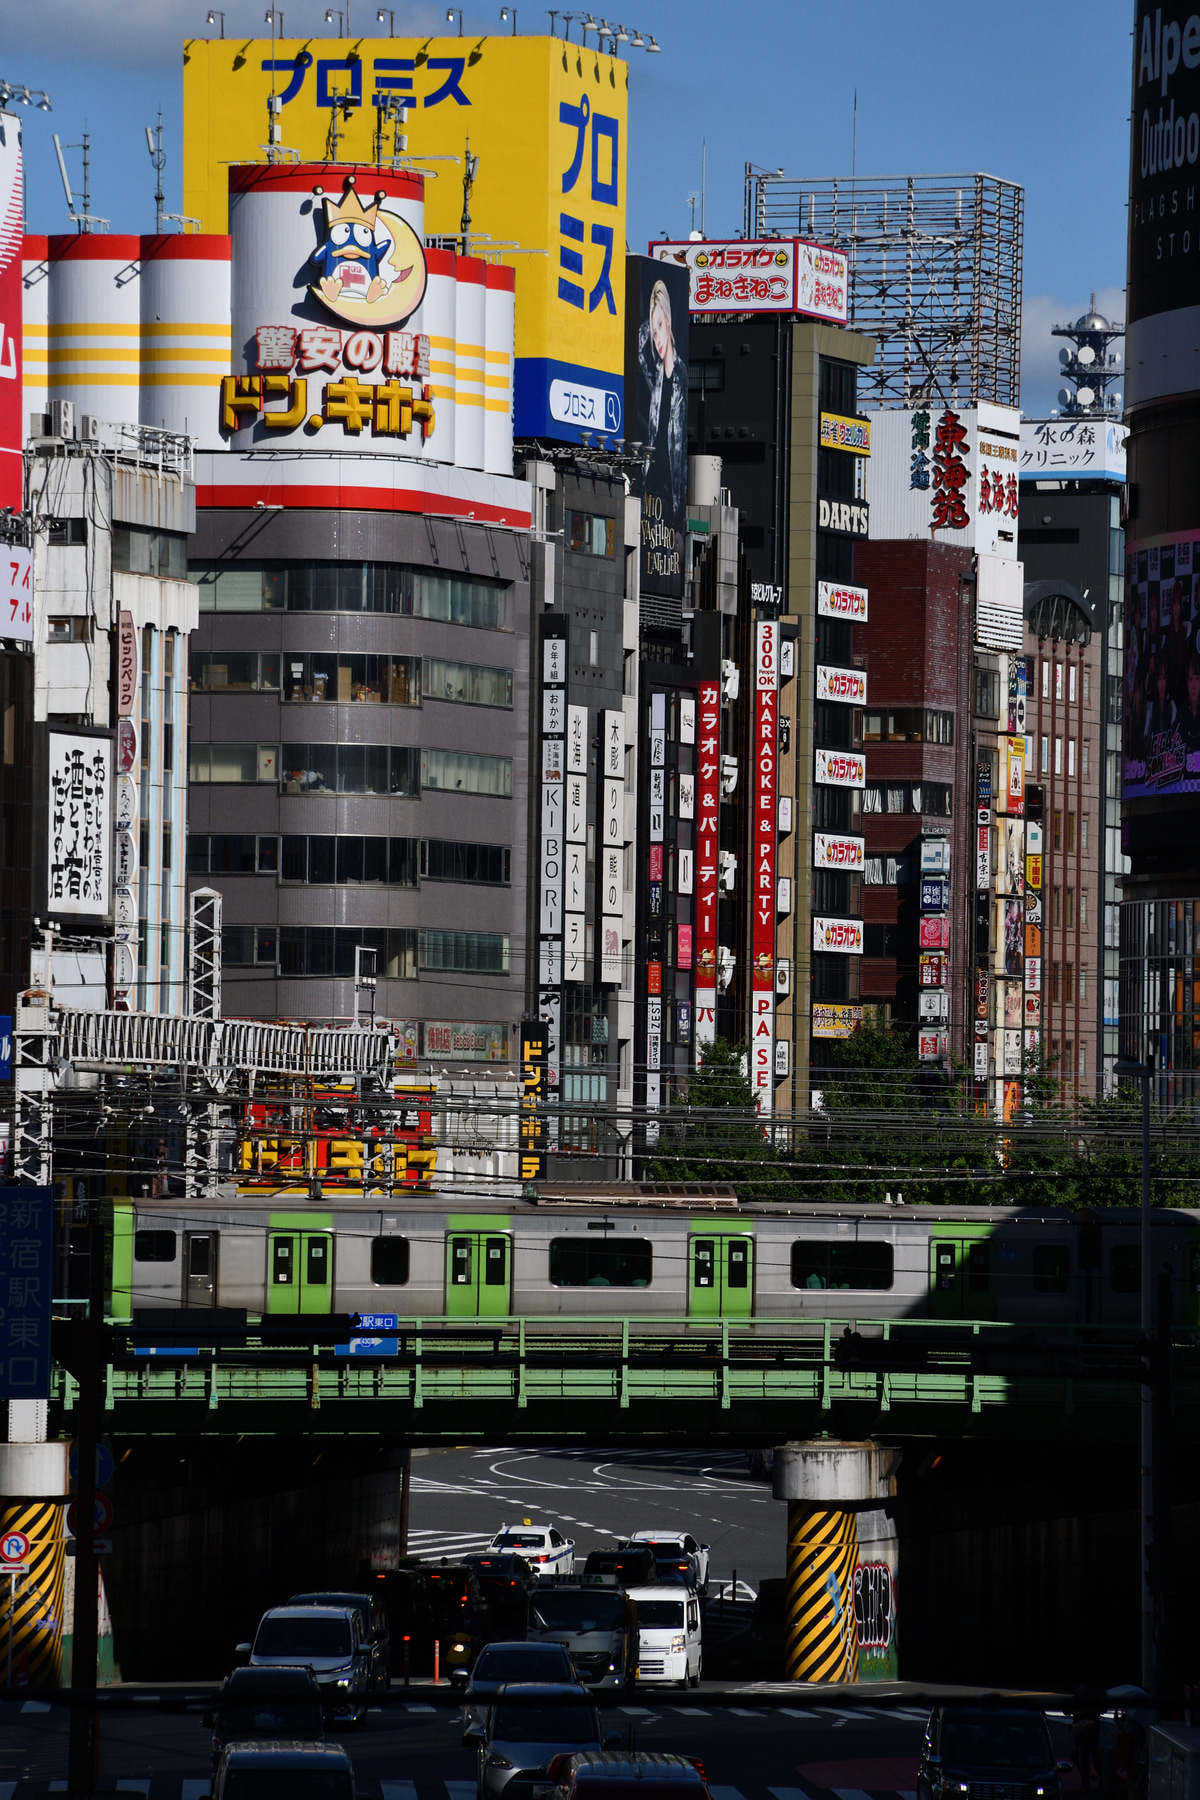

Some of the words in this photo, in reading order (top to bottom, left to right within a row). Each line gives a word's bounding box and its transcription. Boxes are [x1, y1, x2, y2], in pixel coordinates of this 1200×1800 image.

[1138, 8, 1200, 97] Alpe
[261, 51, 471, 109] プロミス
[709, 250, 776, 268] カラオケ
[1156, 230, 1200, 260] STO
[817, 257, 841, 282] カラオケ
[695, 275, 787, 304] まねきねこ
[815, 281, 843, 310] まねきねこ
[256, 326, 430, 377] 驚安の殿堂
[563, 392, 596, 421] プロミス
[1039, 426, 1096, 446] 水の森
[929, 410, 973, 530] 東海苑
[1020, 449, 1096, 468] クリニック
[979, 463, 1019, 519] 東海苑
[818, 499, 868, 535] DARTS
[835, 590, 861, 614] カラオケ
[549, 642, 559, 680] 6年4組
[761, 625, 773, 669] 300
[758, 669, 776, 677] People
[758, 676, 775, 687] OK
[833, 674, 859, 697] カラオケ
[549, 693, 559, 730] おかか
[760, 692, 773, 809] KARAOKE
[832, 759, 859, 780] カラオケ
[760, 820, 772, 833] &
[546, 788, 559, 929] KIBORI
[831, 843, 858, 865] カラオケ
[758, 843, 772, 925] PARTY
[830, 926, 857, 947] カラオケ
[8, 1197, 44, 1387] 新宿駅東口
